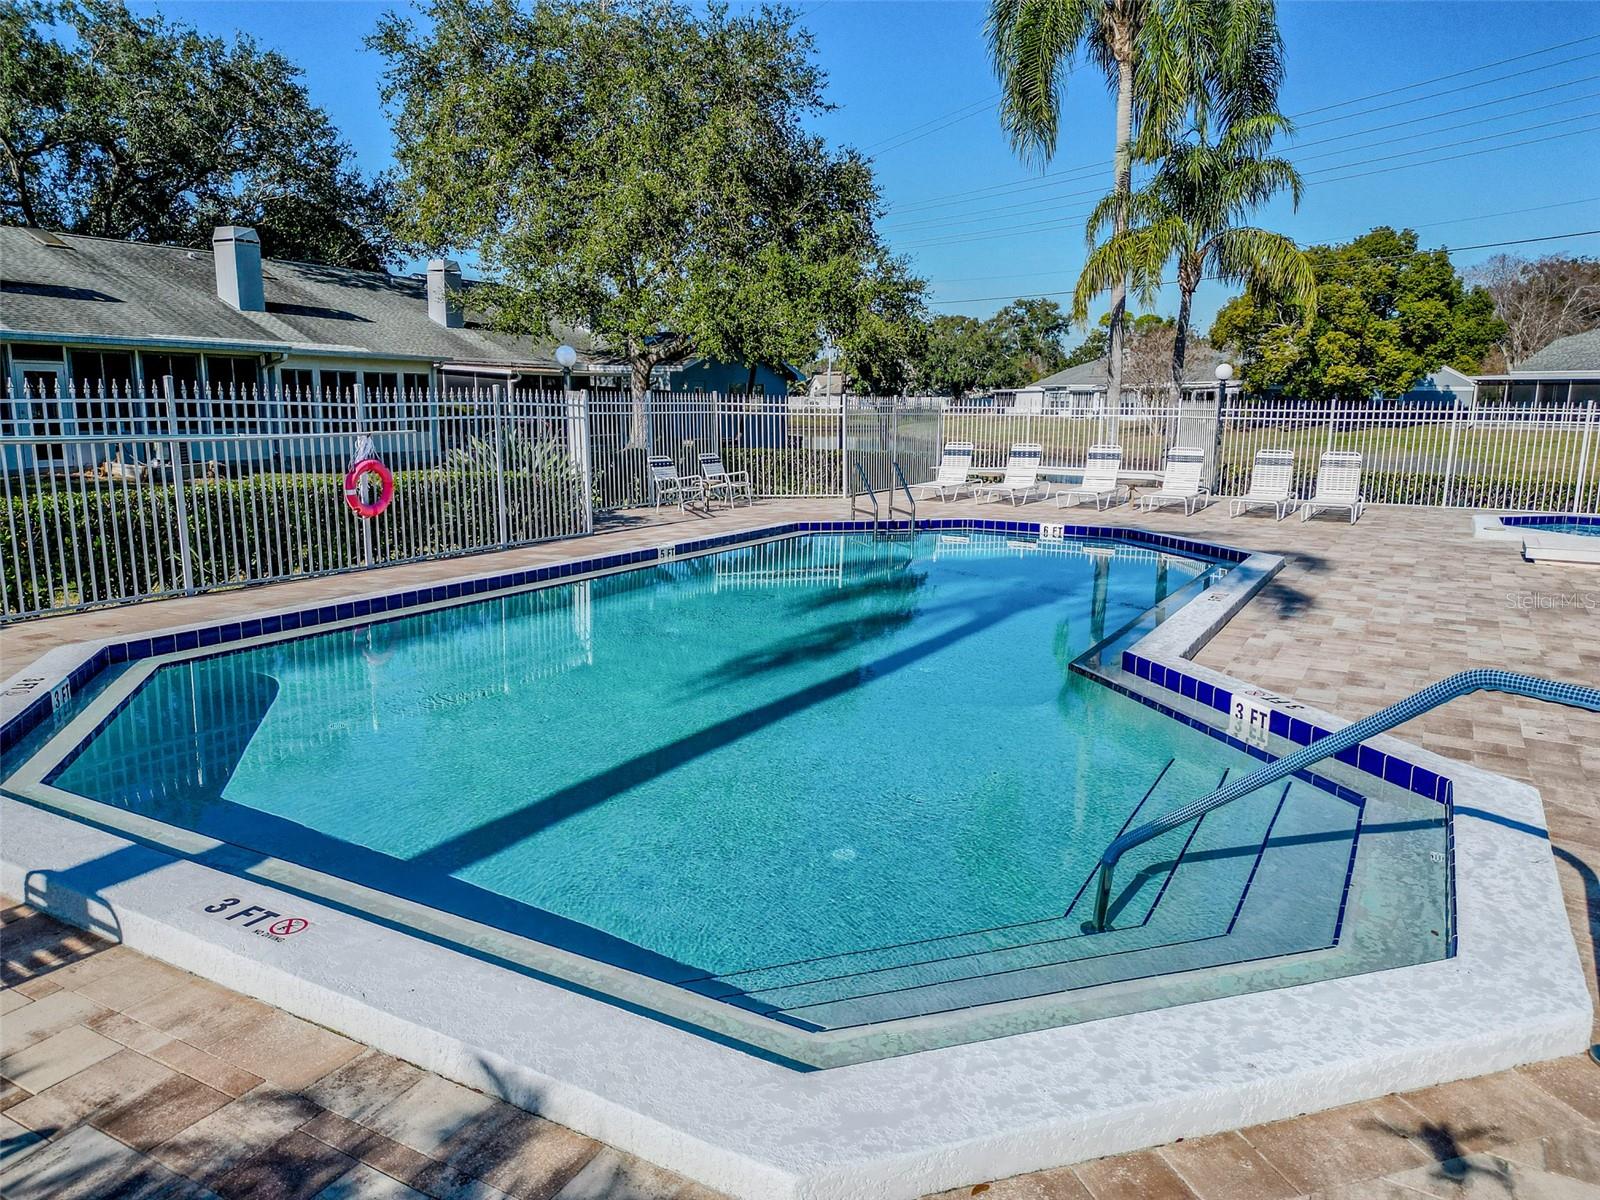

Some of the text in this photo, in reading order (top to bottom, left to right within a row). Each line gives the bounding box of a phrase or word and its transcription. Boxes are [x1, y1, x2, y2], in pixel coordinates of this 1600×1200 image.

[660, 547, 675, 559] 5 FT
[54, 683, 70, 708] 3 FT
[1235, 703, 1268, 729] 3 FT
[204, 898, 281, 928] 3 FT
